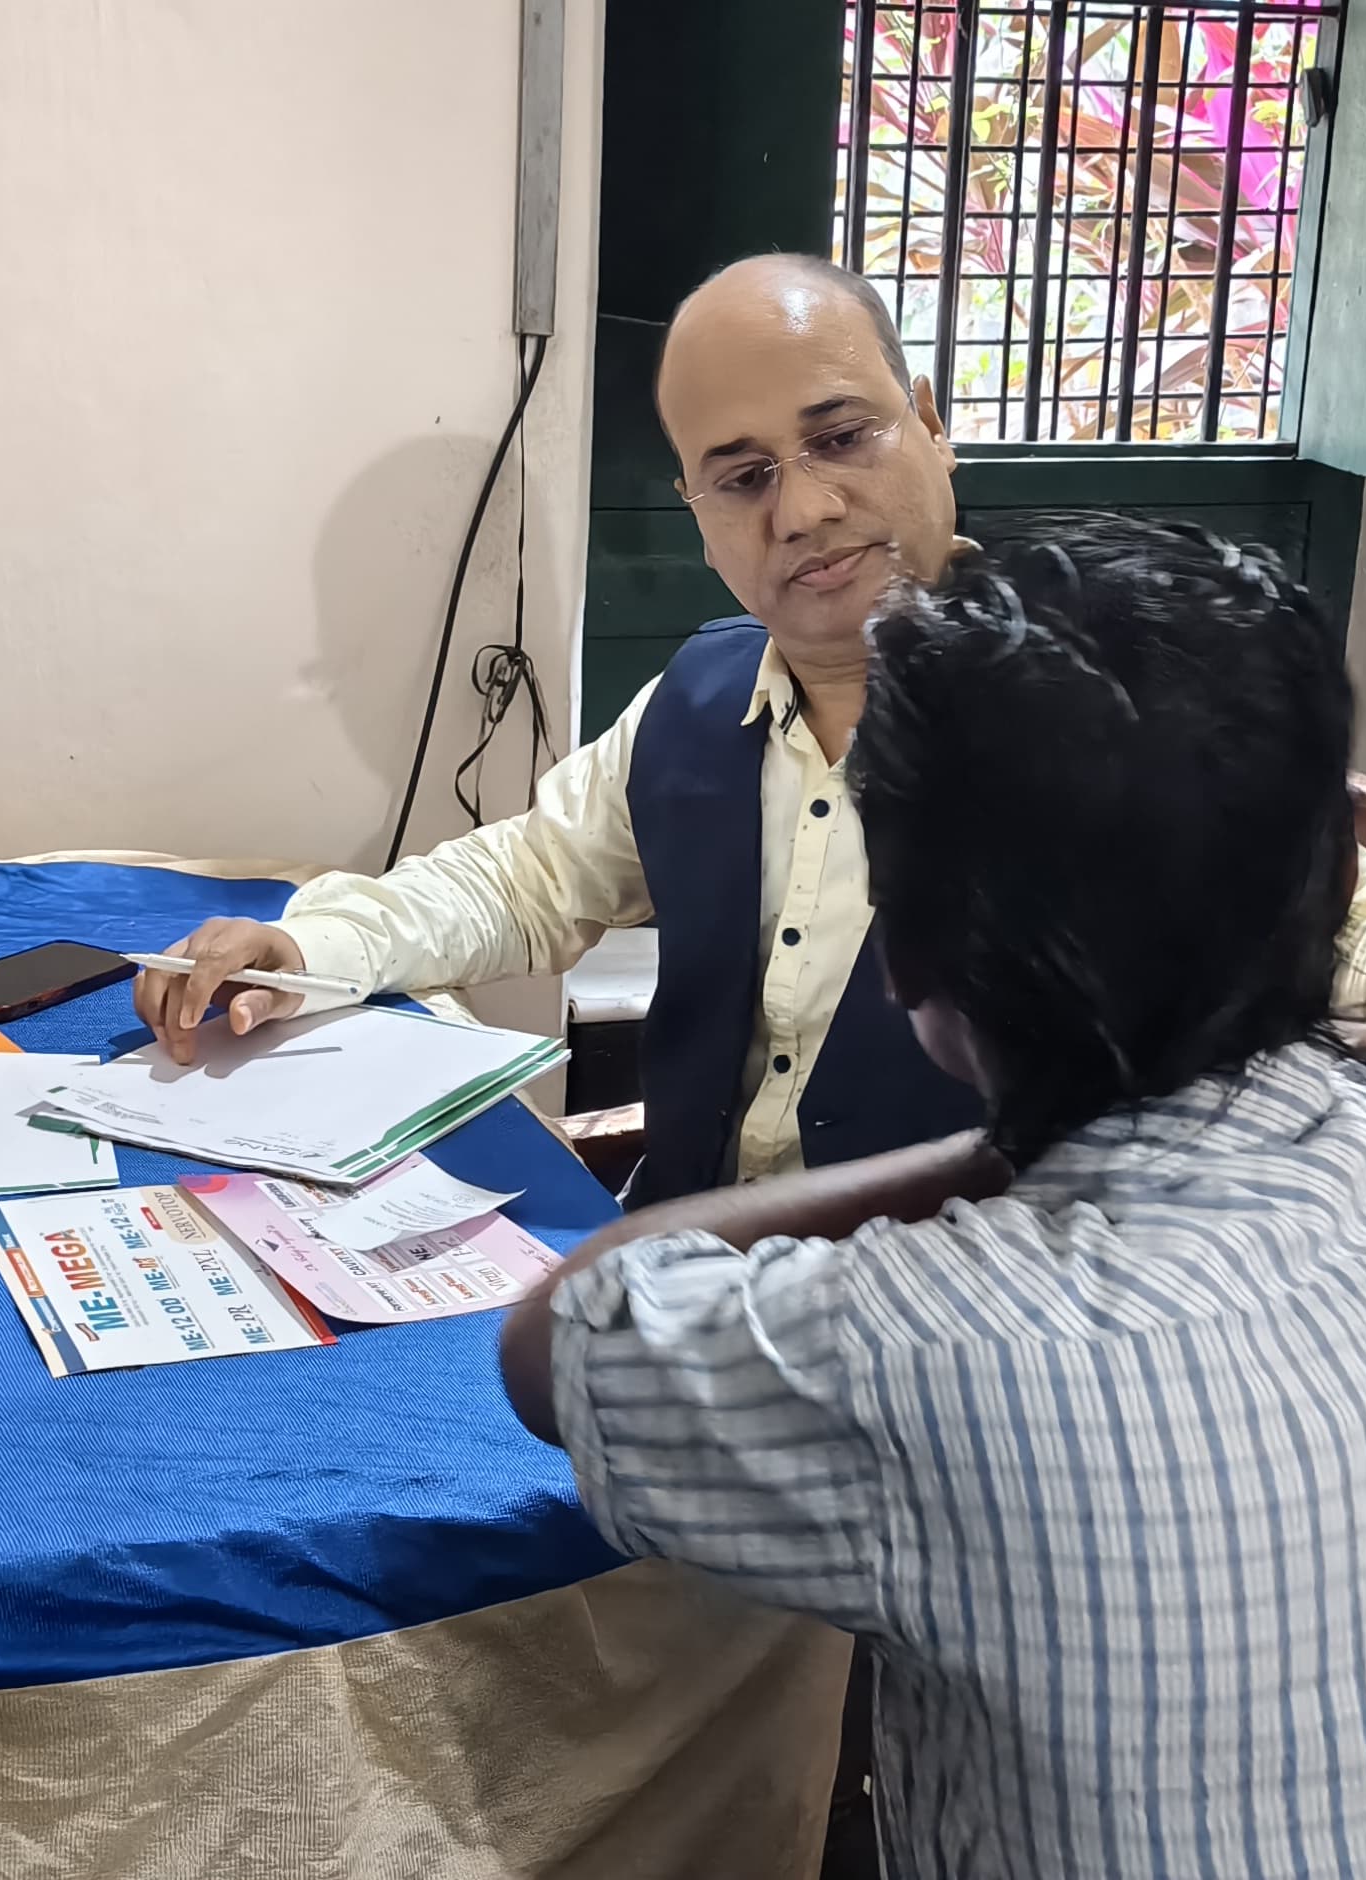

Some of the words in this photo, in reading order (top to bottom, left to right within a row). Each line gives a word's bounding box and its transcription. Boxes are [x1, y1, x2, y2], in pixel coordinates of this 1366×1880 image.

[110, 1216, 147, 1249] ME-12
[154, 1192, 200, 1239] NERVOTOP
[45, 1228, 128, 1332] ME-MEGA
[193, 1249, 236, 1295] ME-PXL
[160, 1297, 183, 1313] OD
[228, 1304, 270, 1344] ME-PR
[172, 1316, 209, 1351] ME-12
